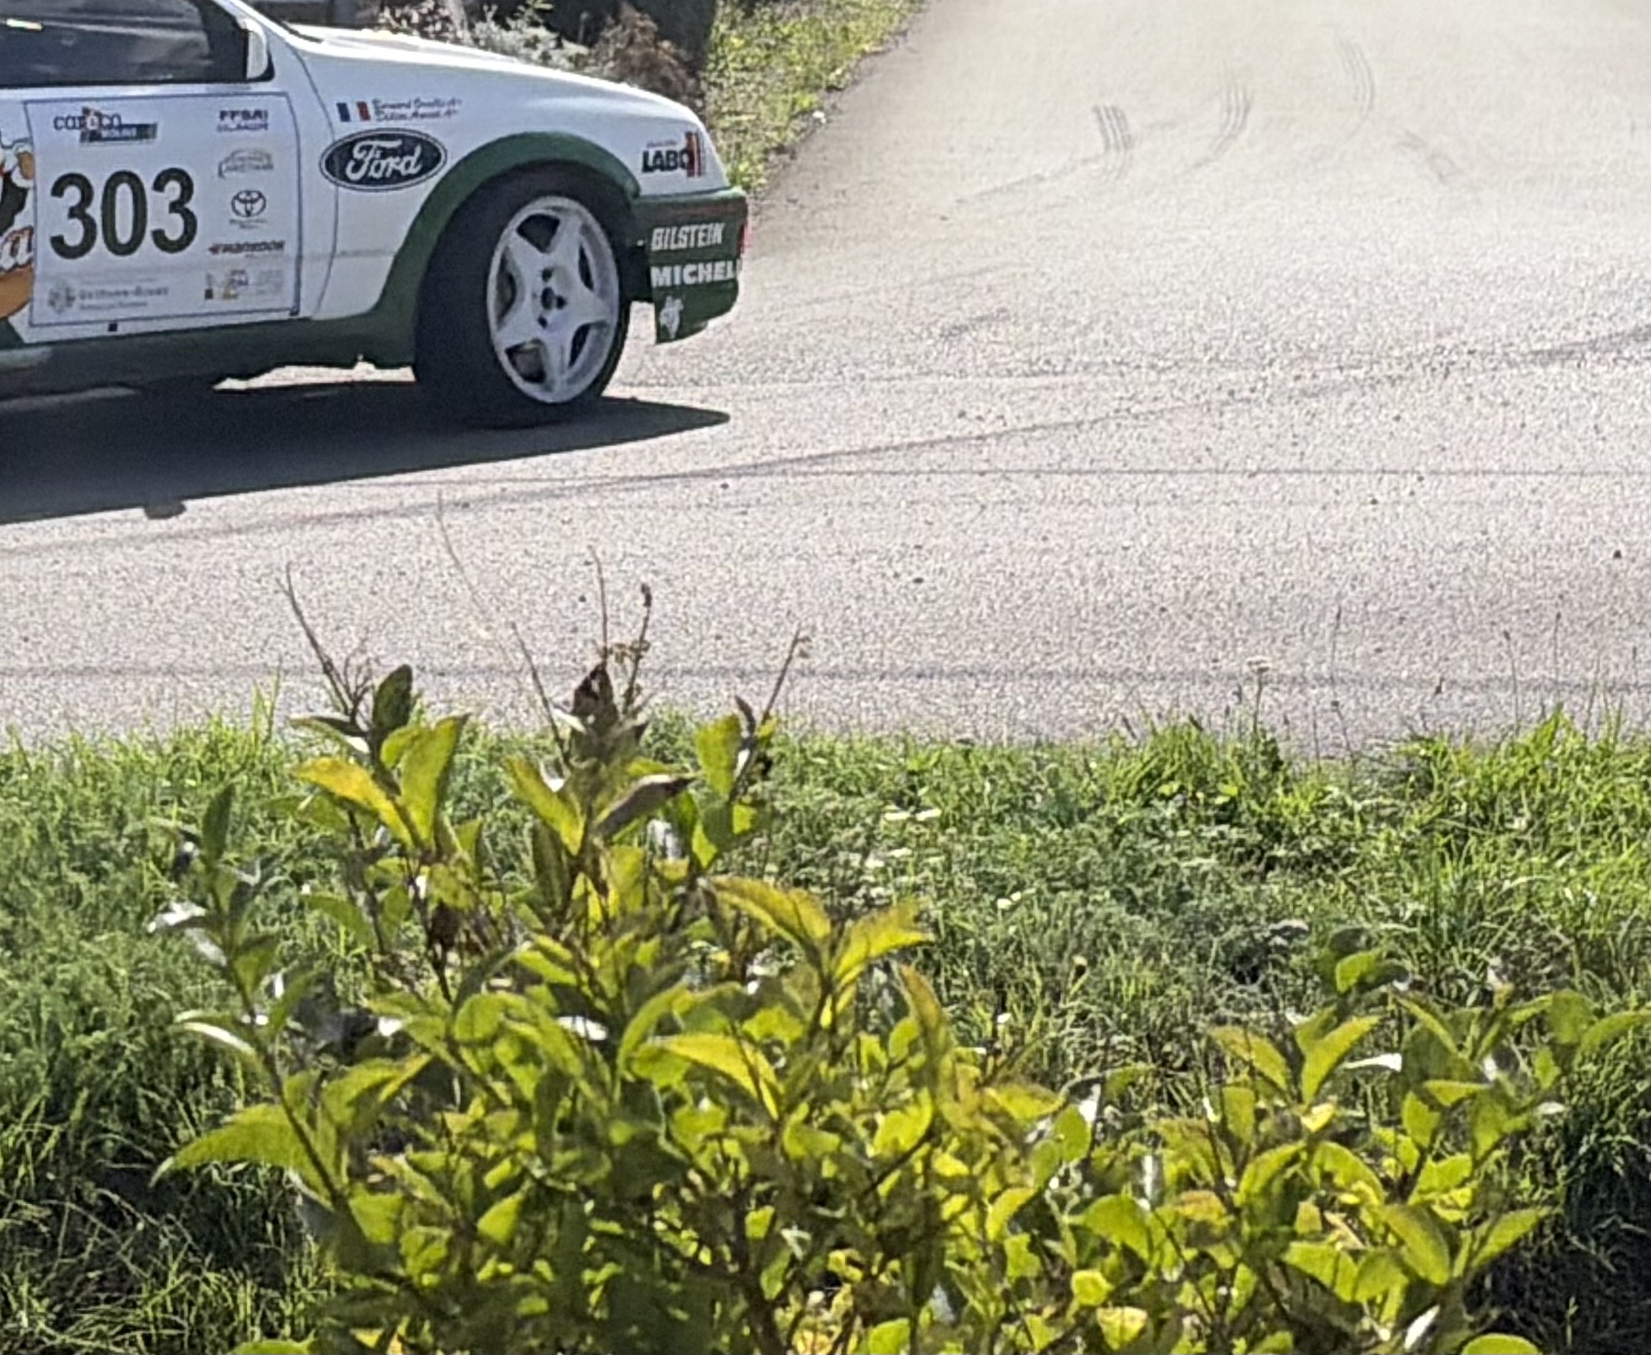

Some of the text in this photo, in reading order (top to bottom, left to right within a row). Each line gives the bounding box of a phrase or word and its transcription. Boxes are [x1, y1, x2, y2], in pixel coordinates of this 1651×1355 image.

[345, 139, 422, 181] Ford
[50, 167, 198, 260] 303
[651, 222, 725, 252] BILSTEIN
